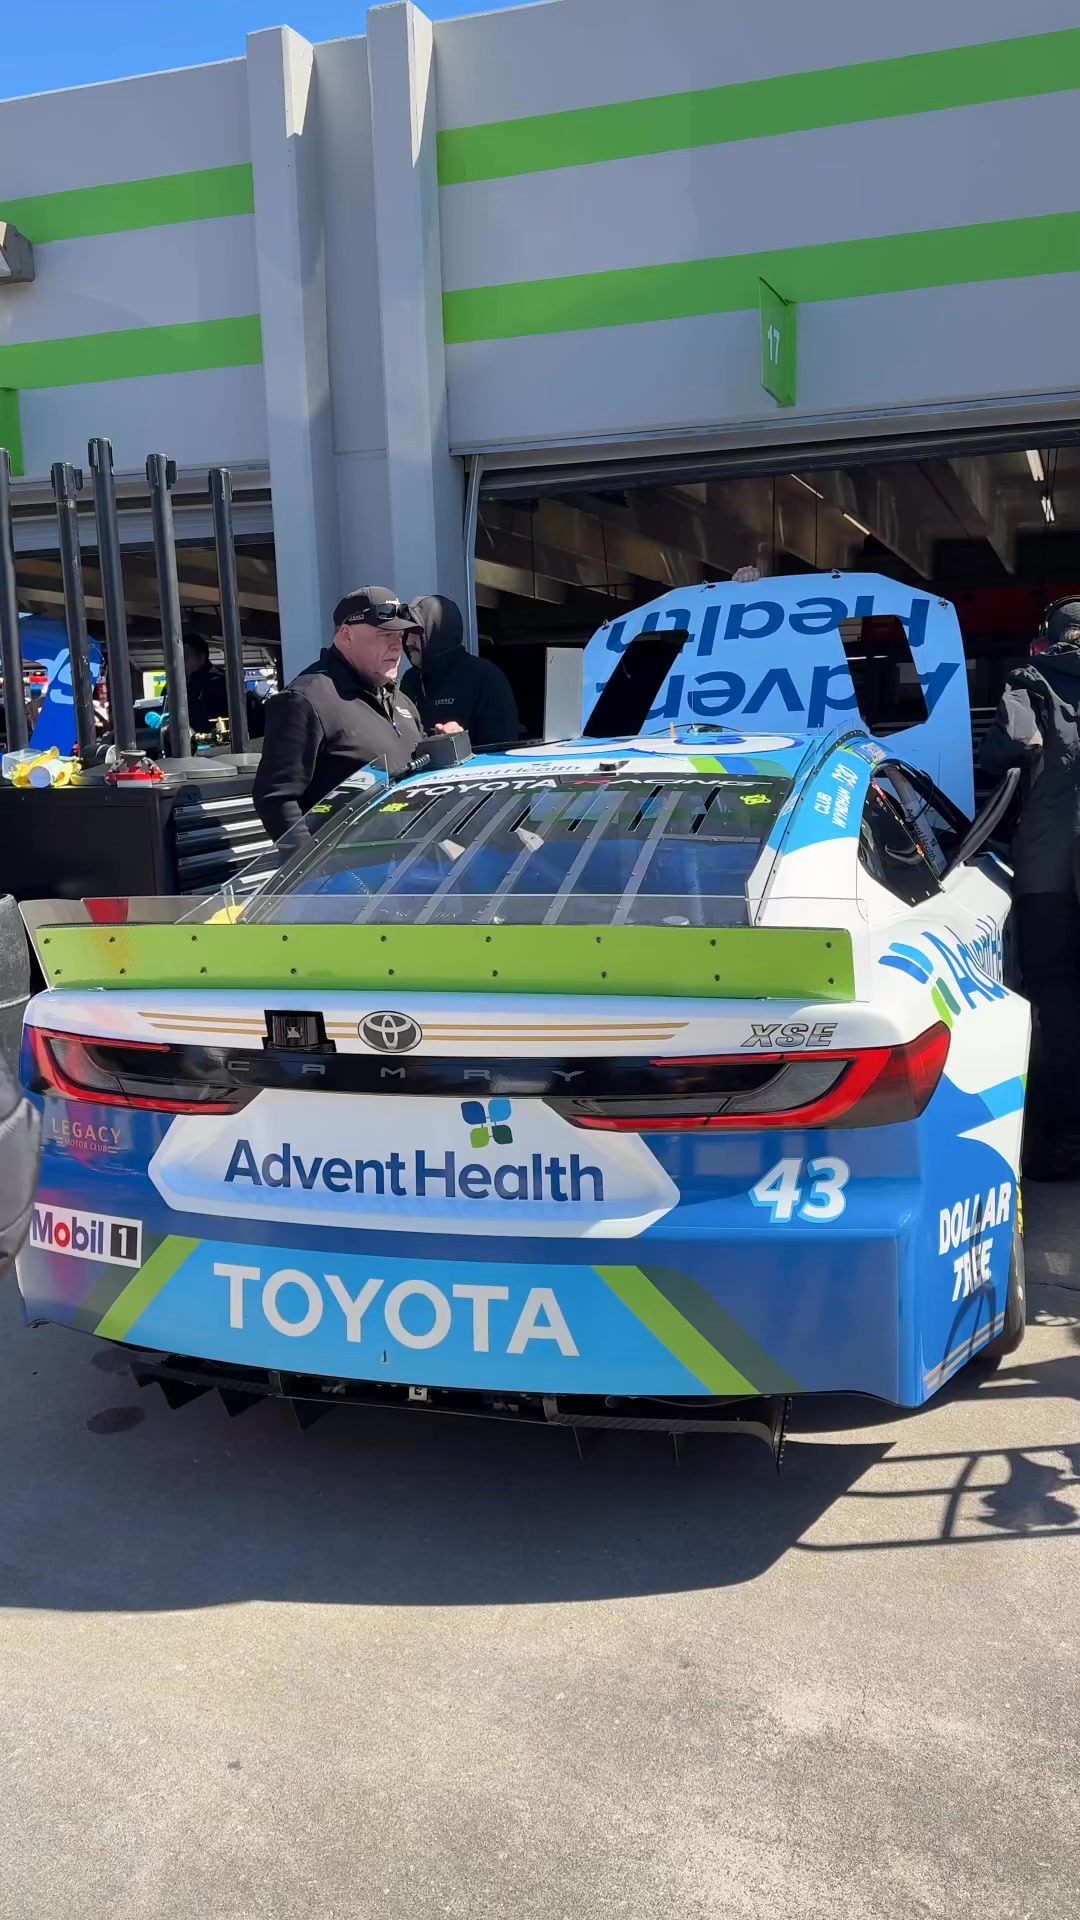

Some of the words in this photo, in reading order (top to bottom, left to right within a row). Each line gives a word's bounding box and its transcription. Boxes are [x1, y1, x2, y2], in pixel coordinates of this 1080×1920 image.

[767, 324, 780, 365] 17
[405, 778, 558, 799] TOYOTA
[573, 778, 774, 787] RACING
[813, 791, 833, 816] CLUB
[831, 786, 851, 829] WYNDHAM
[740, 1022, 839, 1048] XSE
[227, 1059, 585, 1082] CAMRY
[51, 1117, 122, 1145] LEGACY
[64, 1138, 89, 1149] MOTOR
[89, 1143, 109, 1153] CLUB
[224, 1139, 604, 1202] AdventHealth
[748, 1156, 850, 1224] 43
[31, 1208, 105, 1255] Mobil
[938, 1181, 1012, 1256] DOLLAR
[951, 1237, 994, 1303] TREE
[213, 1262, 580, 1357] TOYOTA
